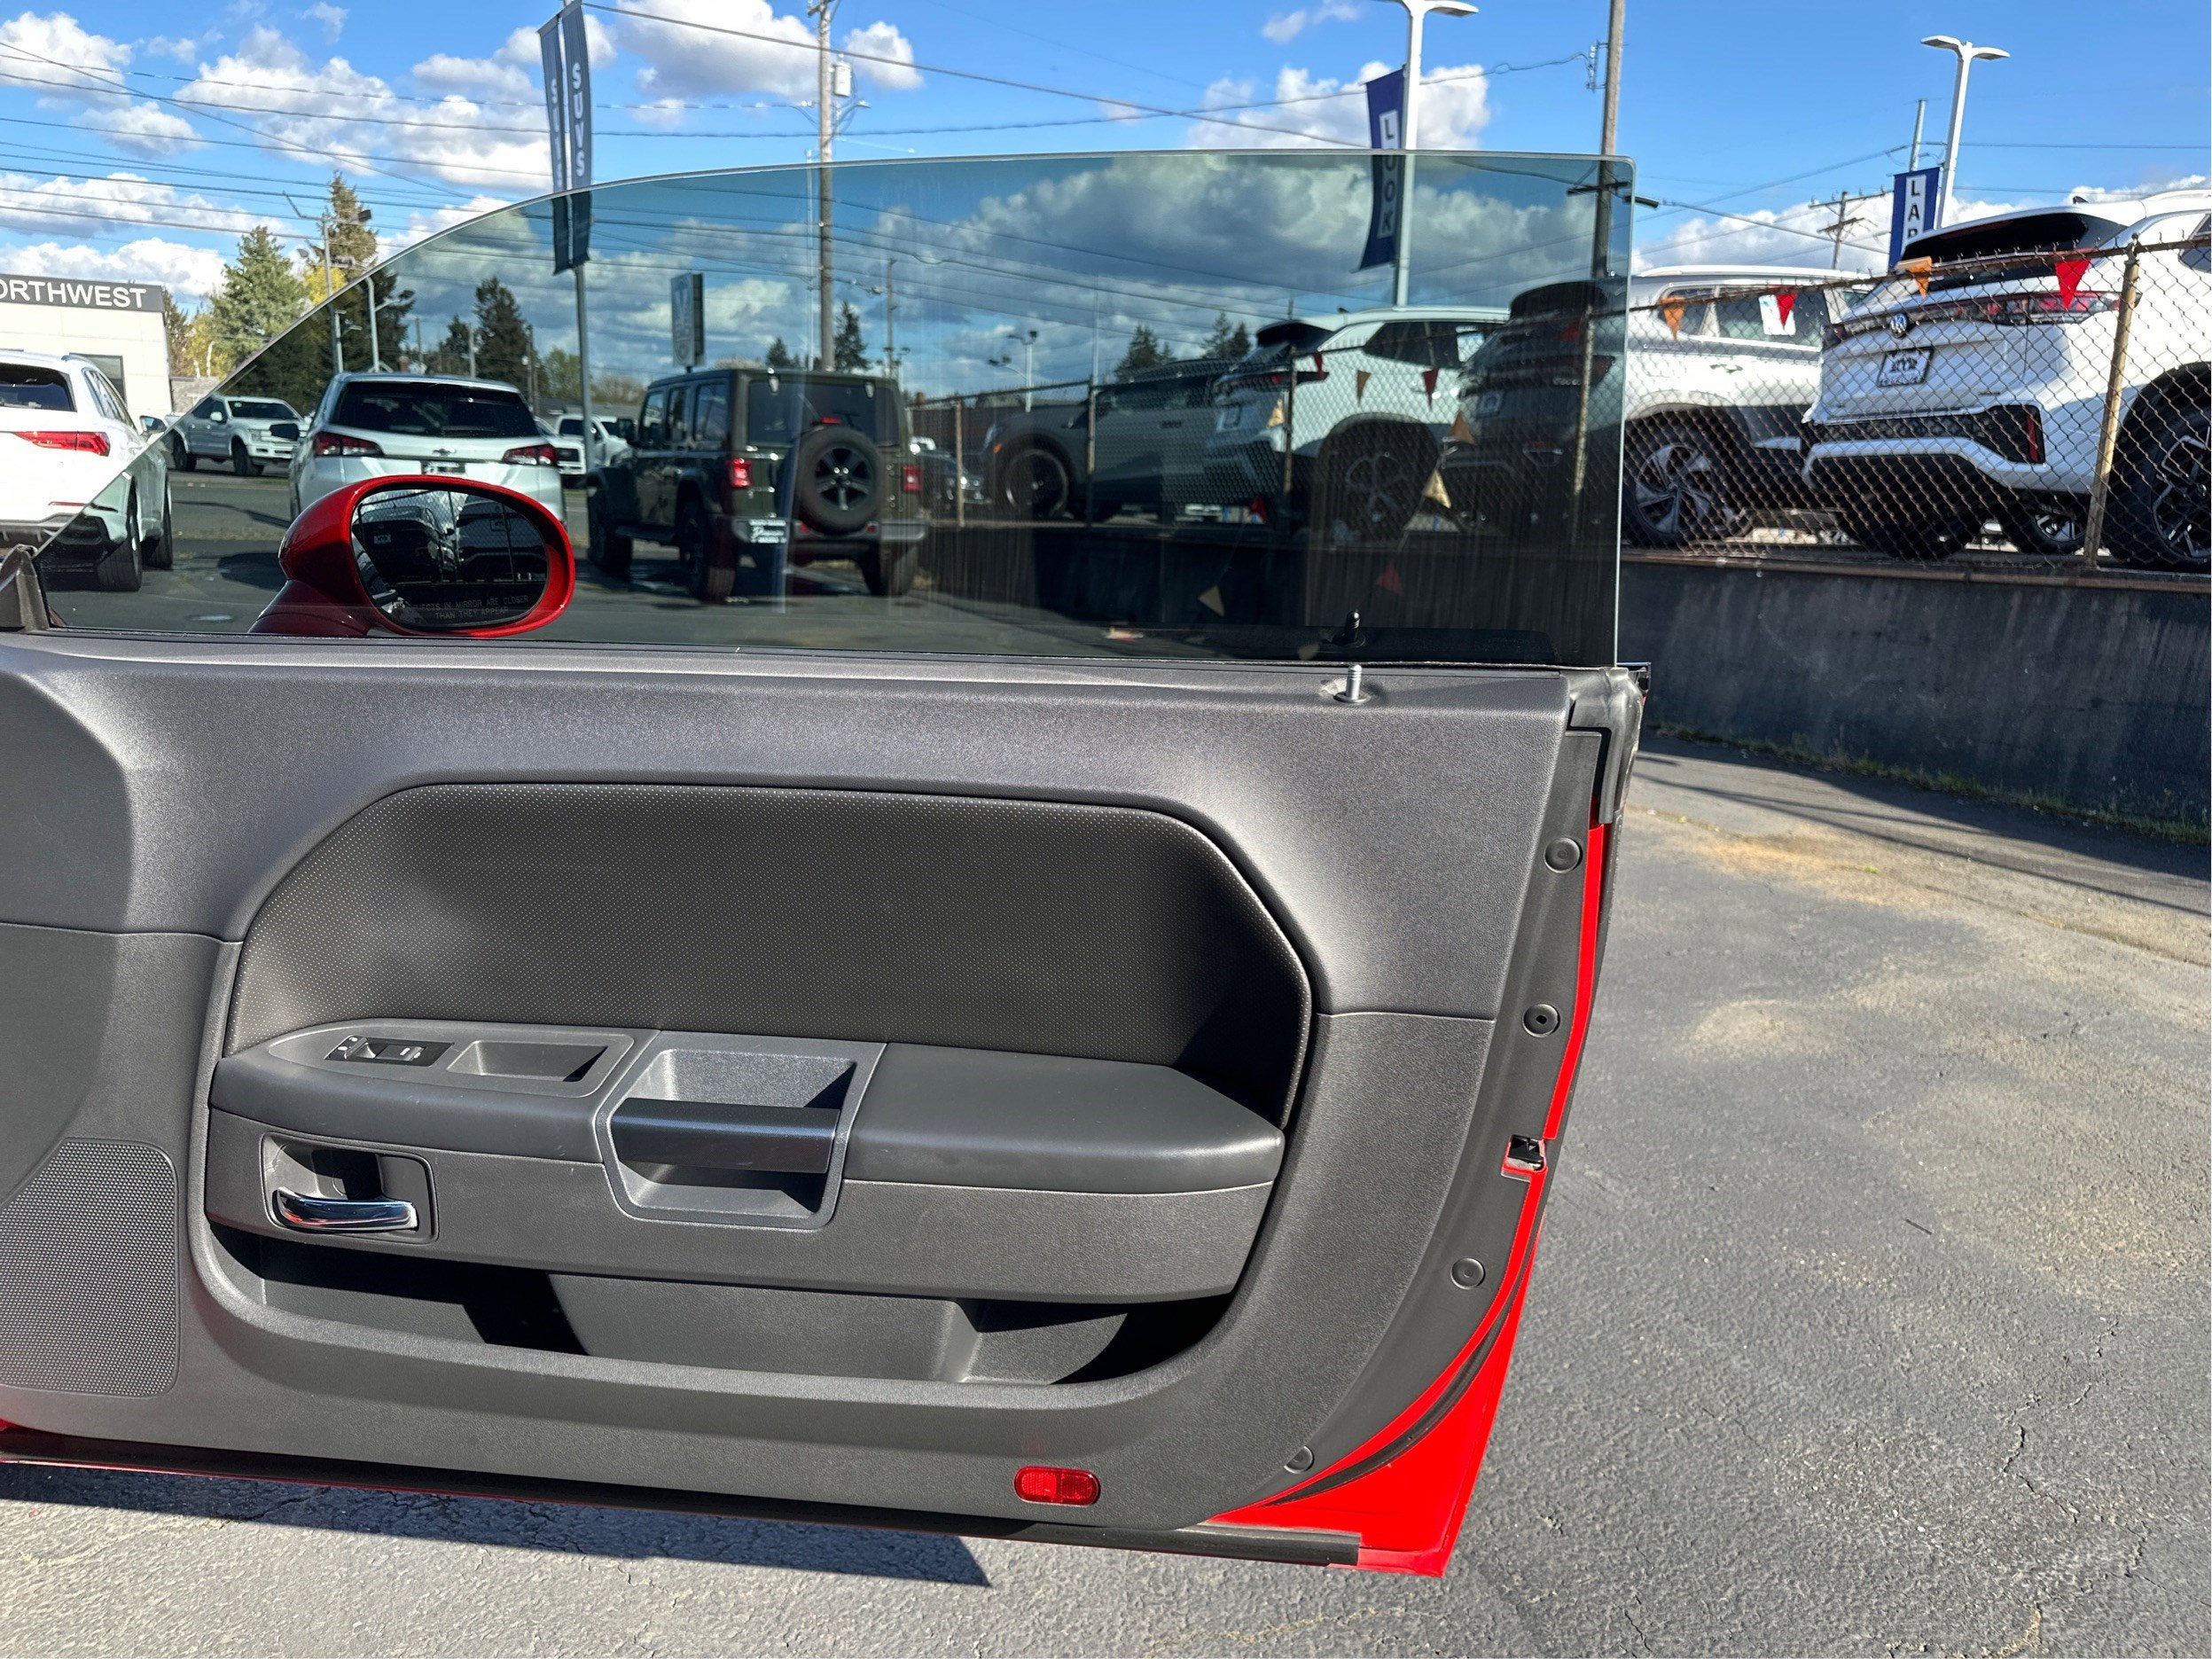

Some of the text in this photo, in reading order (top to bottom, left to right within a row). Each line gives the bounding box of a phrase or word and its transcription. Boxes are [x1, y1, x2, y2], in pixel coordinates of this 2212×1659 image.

[572, 62, 585, 176] SUVS
[455, 599, 482, 609] MIRROR
[487, 598, 499, 606] ARE
[504, 595, 528, 606] CLOSER
[457, 609, 477, 618] THEY
